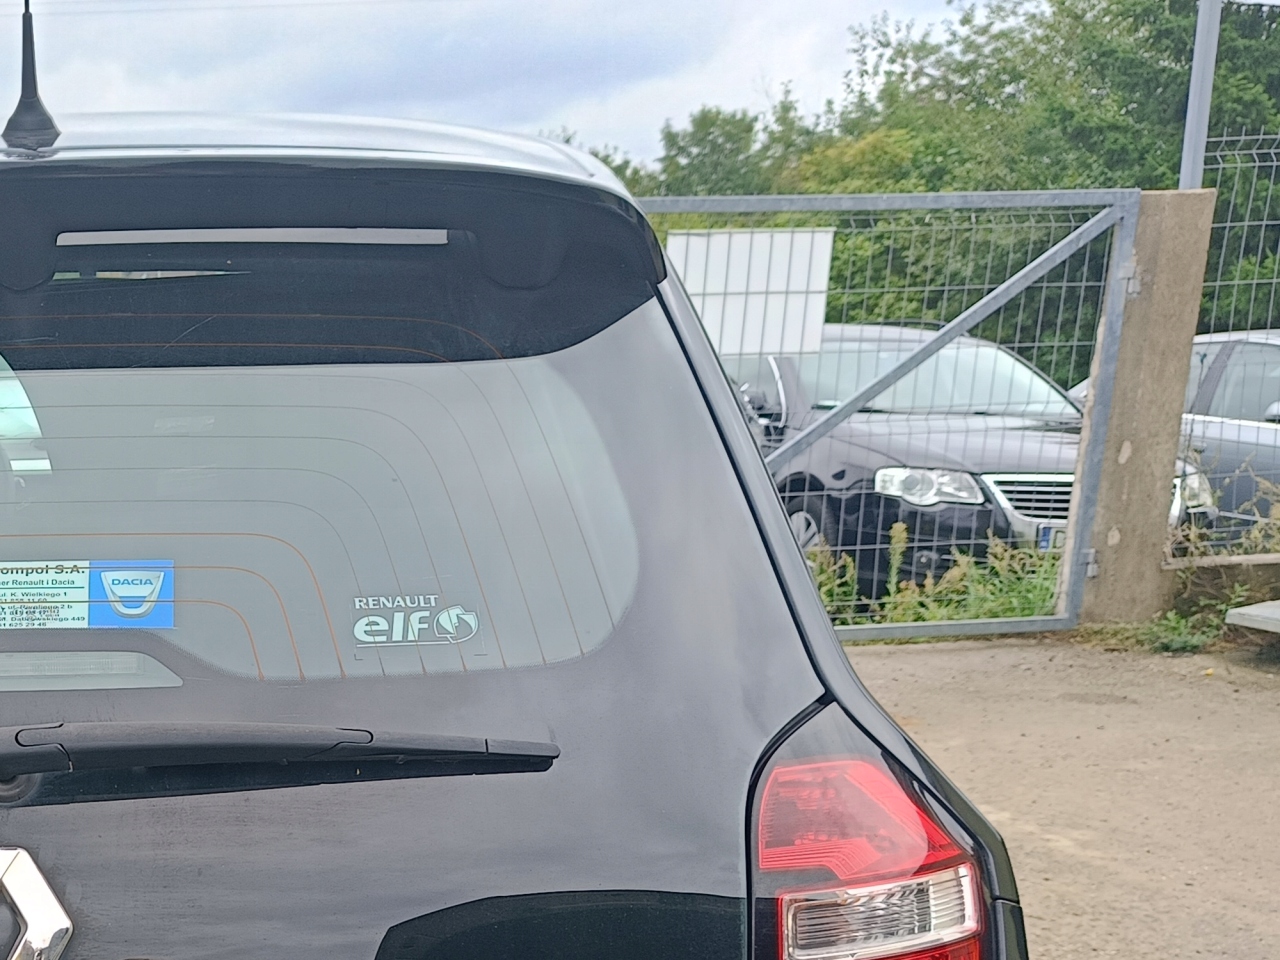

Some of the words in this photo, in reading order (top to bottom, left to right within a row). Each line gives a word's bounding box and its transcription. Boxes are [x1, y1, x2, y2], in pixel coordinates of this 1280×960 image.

[54, 564, 86, 574] S.A.
[111, 578, 154, 586] DACIA
[354, 594, 439, 610] RENAULT
[353, 610, 431, 643] elf
